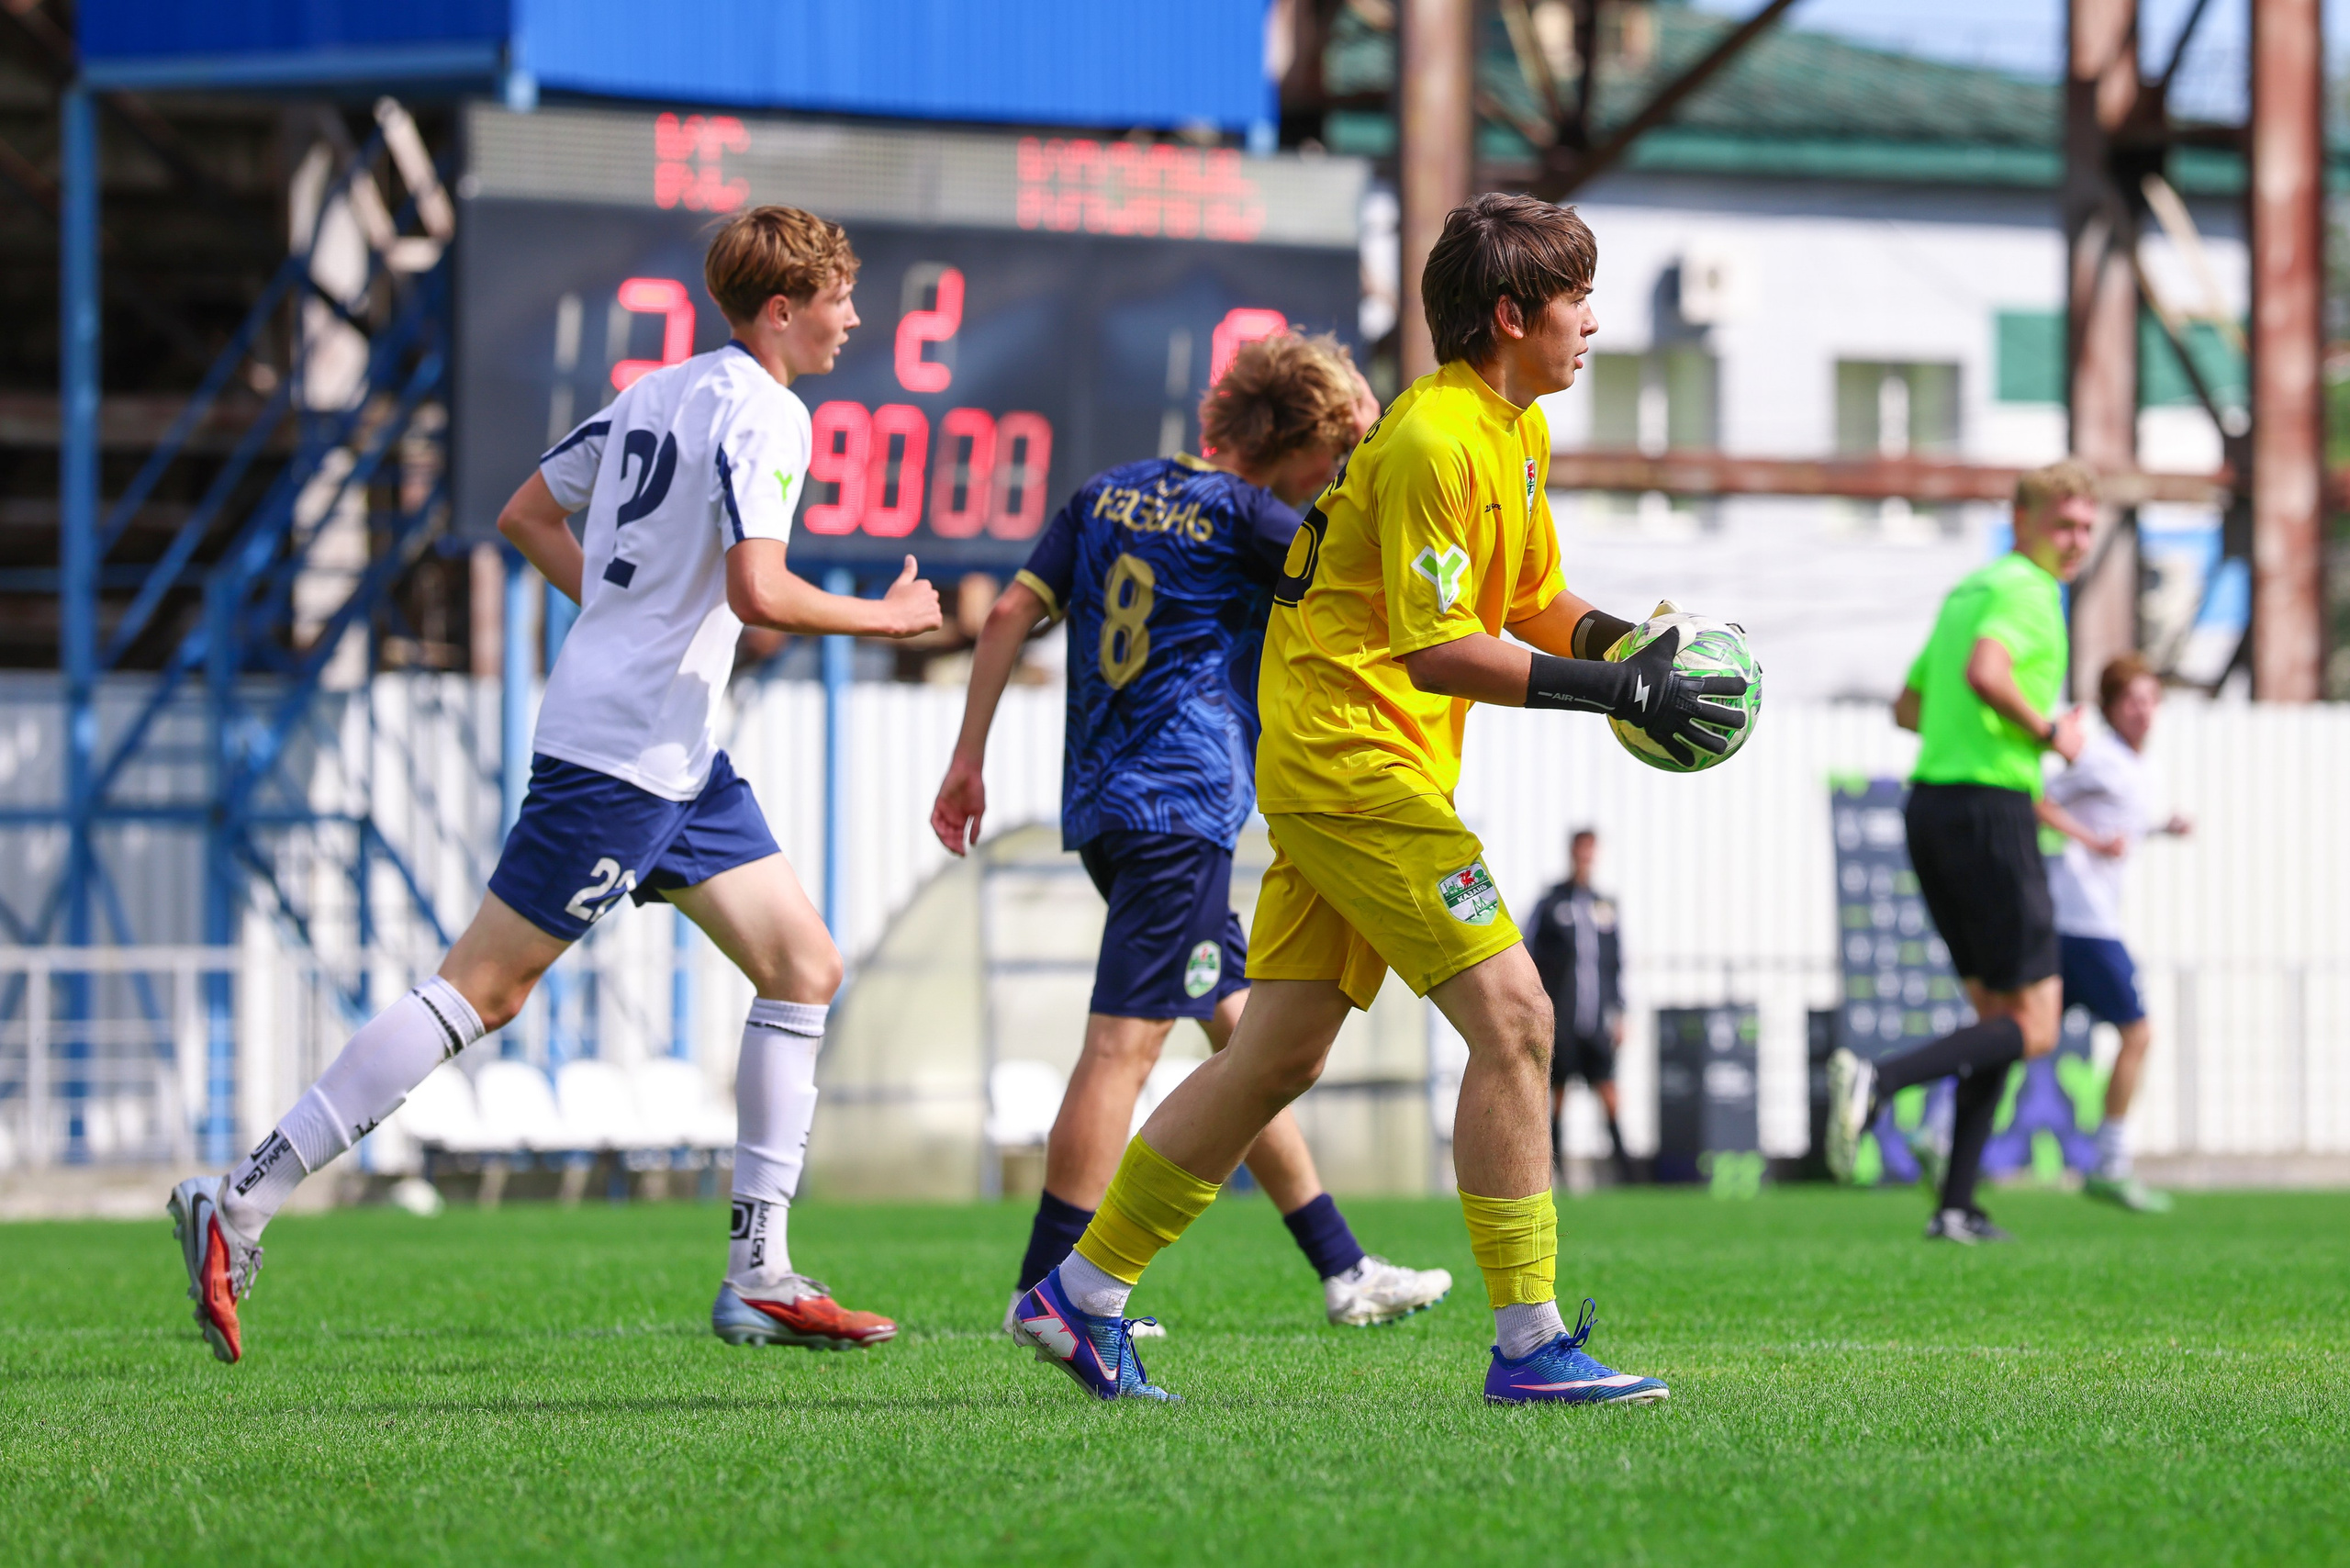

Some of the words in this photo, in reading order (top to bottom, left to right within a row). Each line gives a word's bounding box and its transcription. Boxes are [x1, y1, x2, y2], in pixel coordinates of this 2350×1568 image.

[894, 266, 965, 393] 2
[1099, 552, 1156, 690] 8
[1551, 692, 1574, 702] AIR
[1457, 884, 1488, 903] КАЗАНЬ
